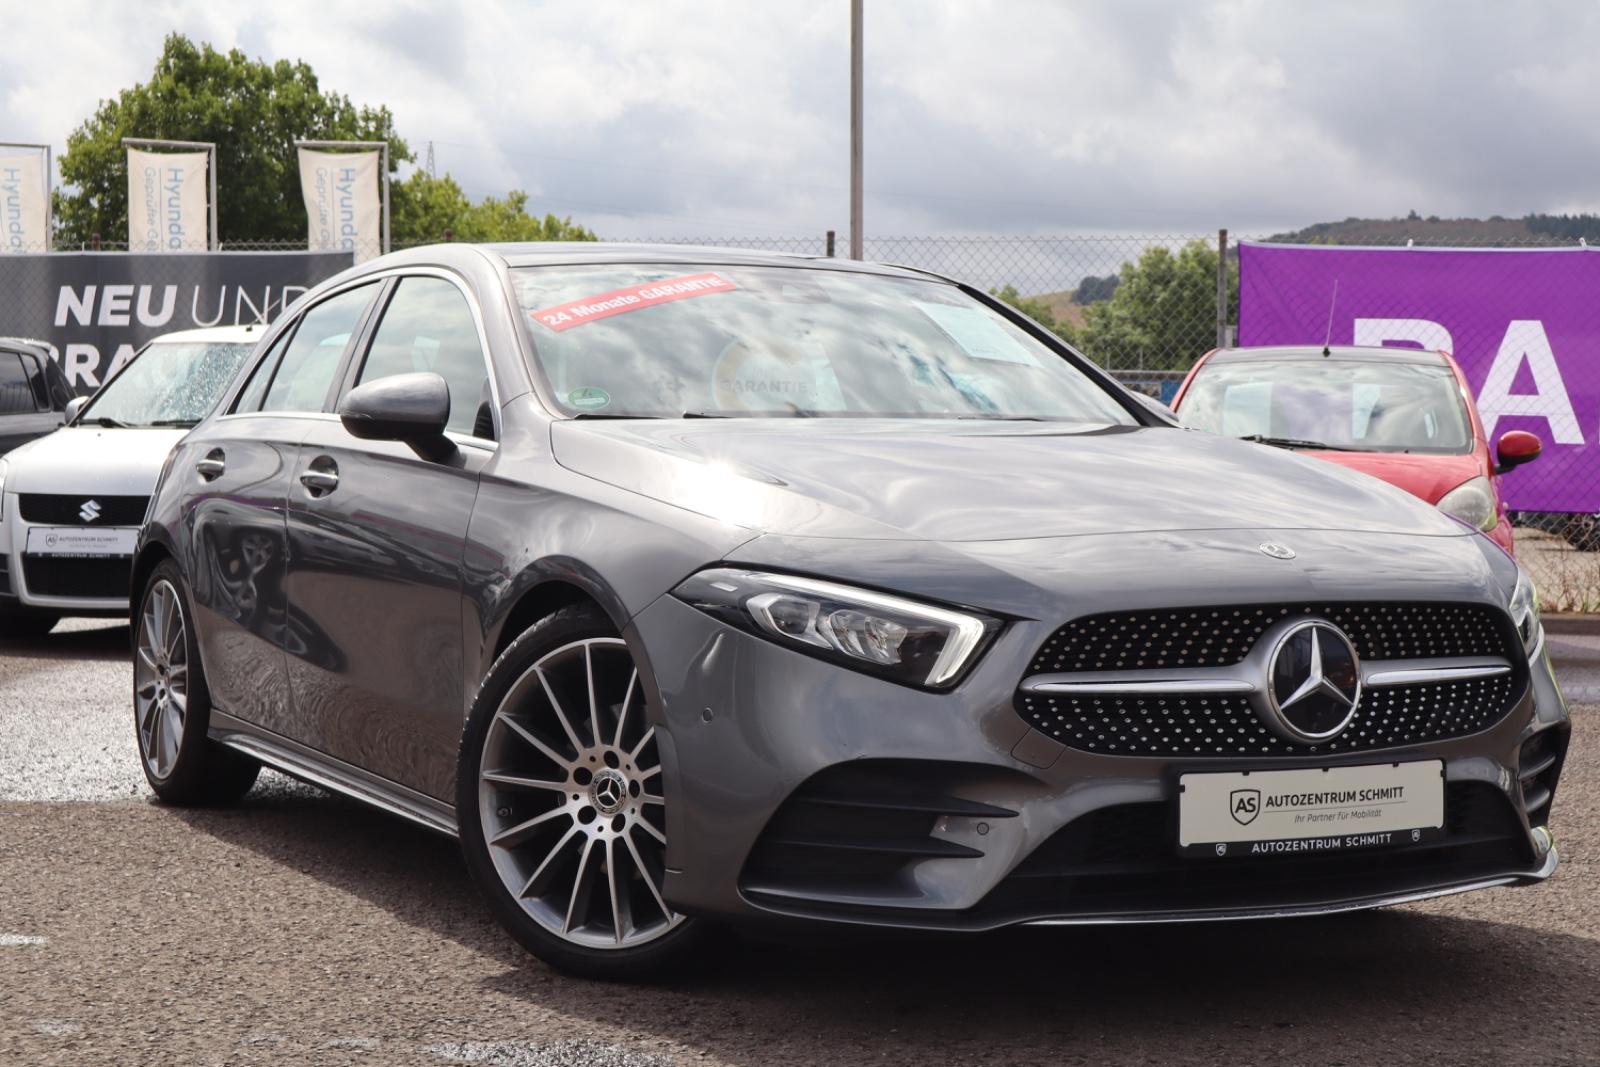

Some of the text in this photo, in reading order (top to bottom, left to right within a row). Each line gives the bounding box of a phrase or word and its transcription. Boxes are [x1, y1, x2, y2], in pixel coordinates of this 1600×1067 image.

[54, 284, 178, 327] NEU
[543, 276, 727, 326] 24 Monate GARANTIE
[1235, 786, 1405, 813] AS AUTOZENTRUM SCHMITT
[1294, 809, 1383, 823] Ihr Partner für Mobilität
[1251, 833, 1392, 853] AUTOZENTRUM SCHMITT
